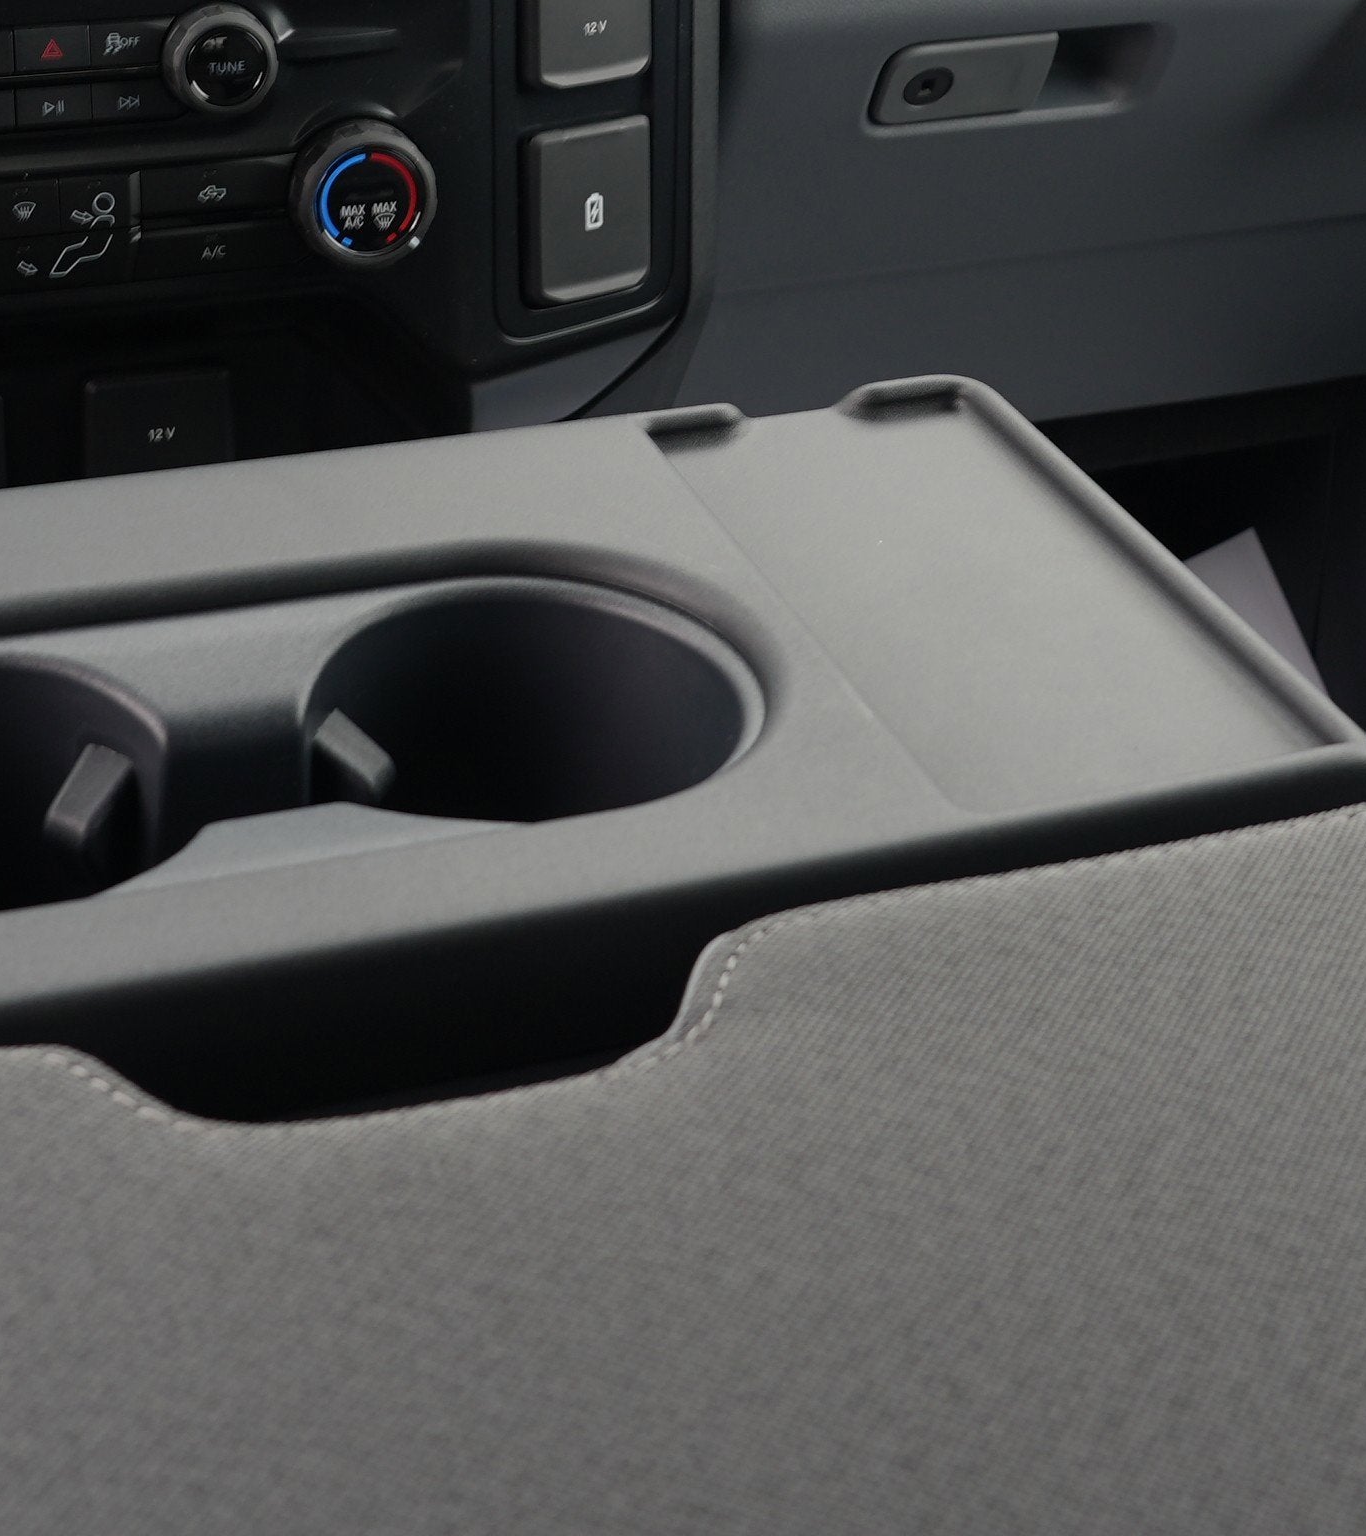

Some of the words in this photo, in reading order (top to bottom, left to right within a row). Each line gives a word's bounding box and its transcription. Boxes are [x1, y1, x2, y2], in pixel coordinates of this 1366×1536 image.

[121, 36, 141, 46] OFF
[207, 60, 247, 76] TUNE
[340, 203, 366, 218] MAX
[371, 200, 397, 214] MAX
[344, 216, 365, 230] A/C
[201, 245, 226, 260] A/C
